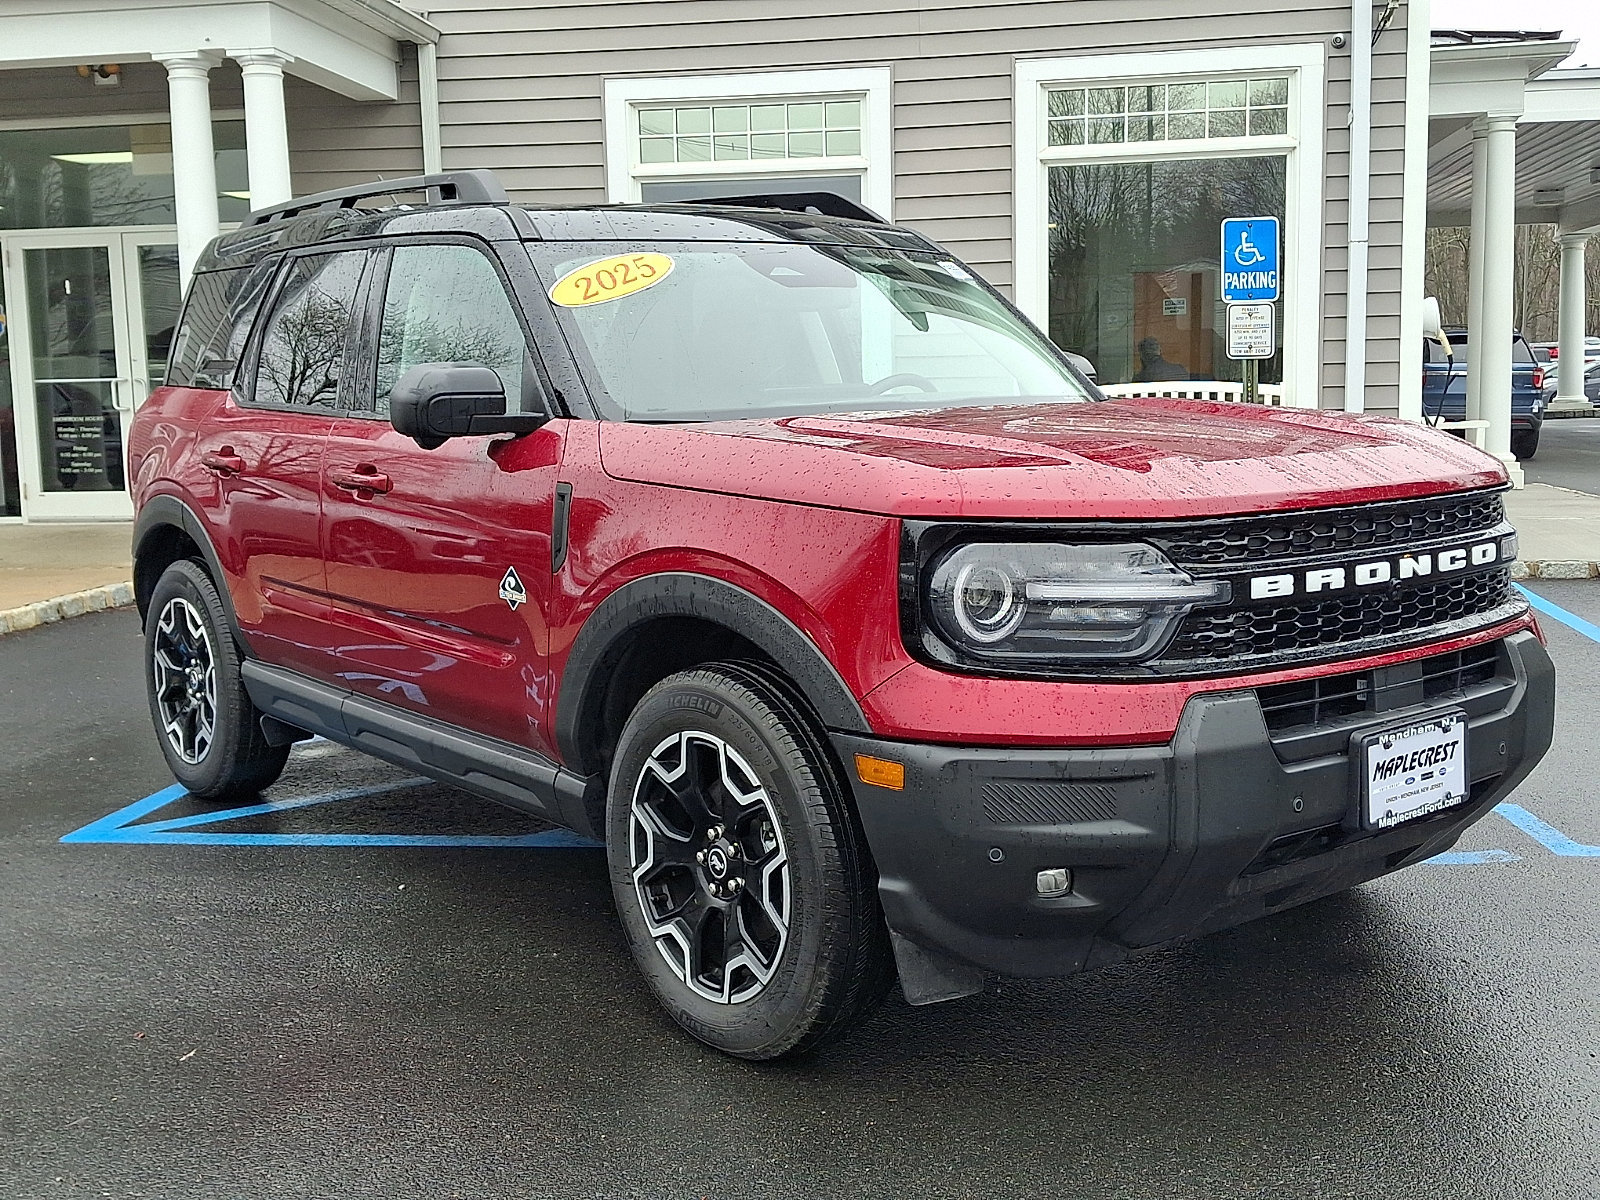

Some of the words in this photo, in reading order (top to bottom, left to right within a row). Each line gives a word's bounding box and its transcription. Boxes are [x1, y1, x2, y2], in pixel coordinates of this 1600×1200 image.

[575, 257, 656, 300] 2025
[1225, 271, 1276, 289] PARKING
[1251, 543, 1497, 600] BRONCO
[1379, 724, 1437, 744] Mendham,
[1442, 717, 1457, 727] NJ
[1373, 740, 1459, 782] MAPLECREST
[1379, 797, 1461, 828] MaplecrestFord.com
